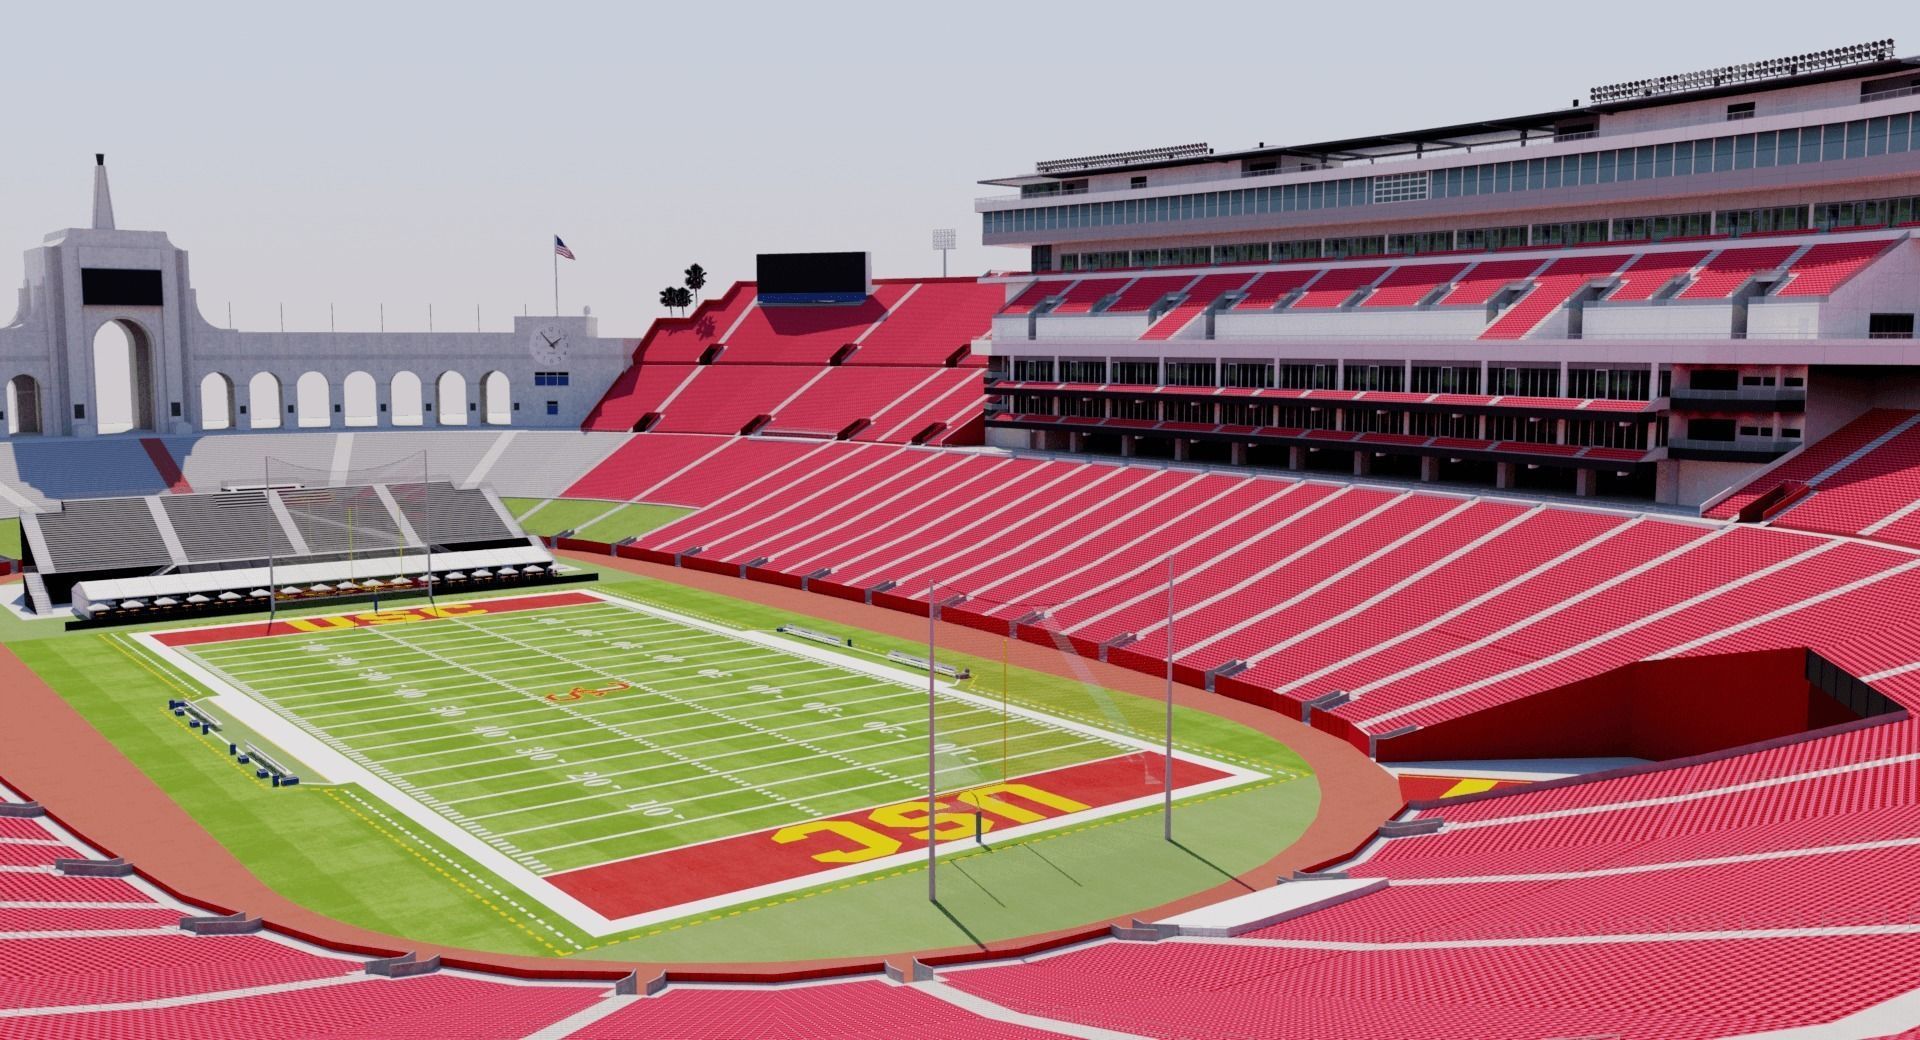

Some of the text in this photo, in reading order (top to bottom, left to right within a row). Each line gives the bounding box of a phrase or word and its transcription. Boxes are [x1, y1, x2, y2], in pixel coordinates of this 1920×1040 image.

[285, 605, 488, 632] USC
[515, 746, 559, 761] 30
[566, 771, 613, 787] 20
[626, 799, 675, 817] 10
[771, 783, 1094, 864] USC
